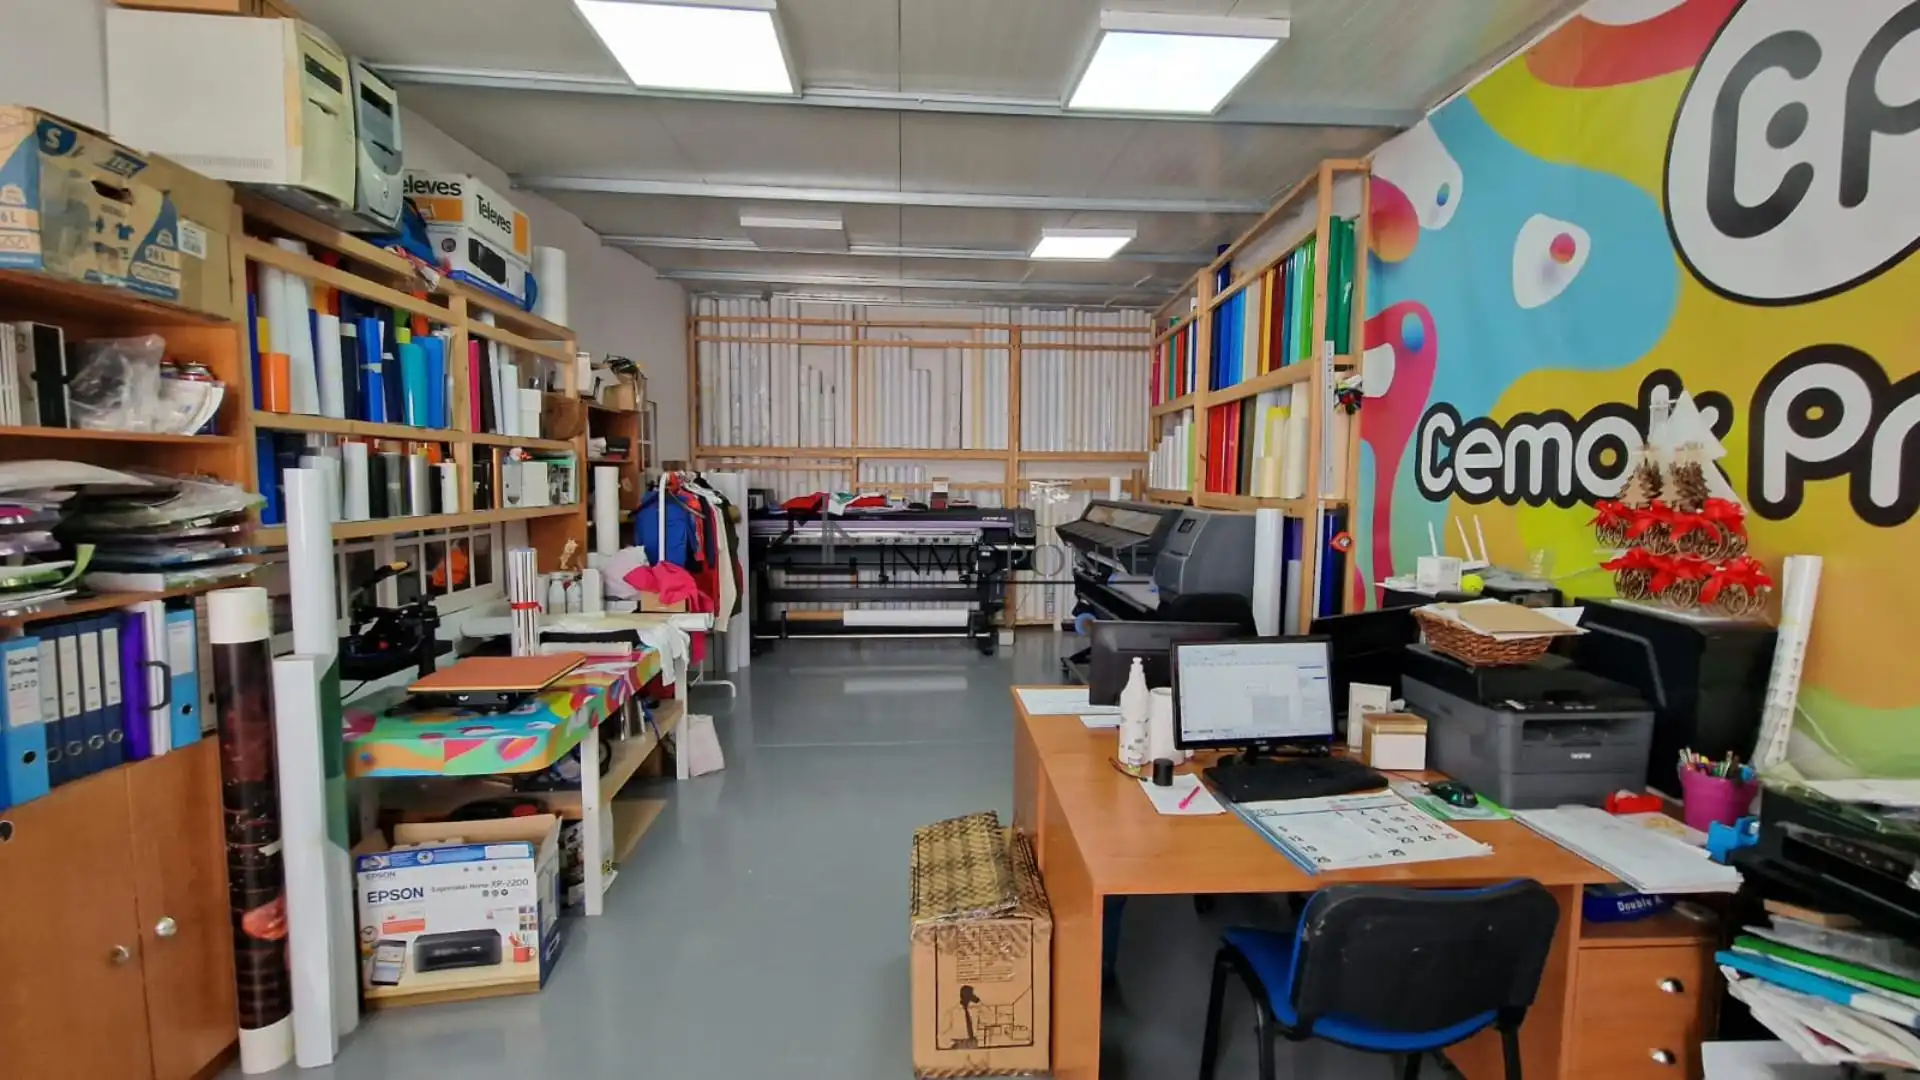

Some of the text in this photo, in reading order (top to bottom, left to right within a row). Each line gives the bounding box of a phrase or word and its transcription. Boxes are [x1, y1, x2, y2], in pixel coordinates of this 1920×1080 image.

[45, 127, 62, 149] S
[402, 174, 462, 196] eleves
[475, 193, 512, 235] Televes
[367, 886, 424, 905] EPSON
[1616, 897, 1653, 912] Double
